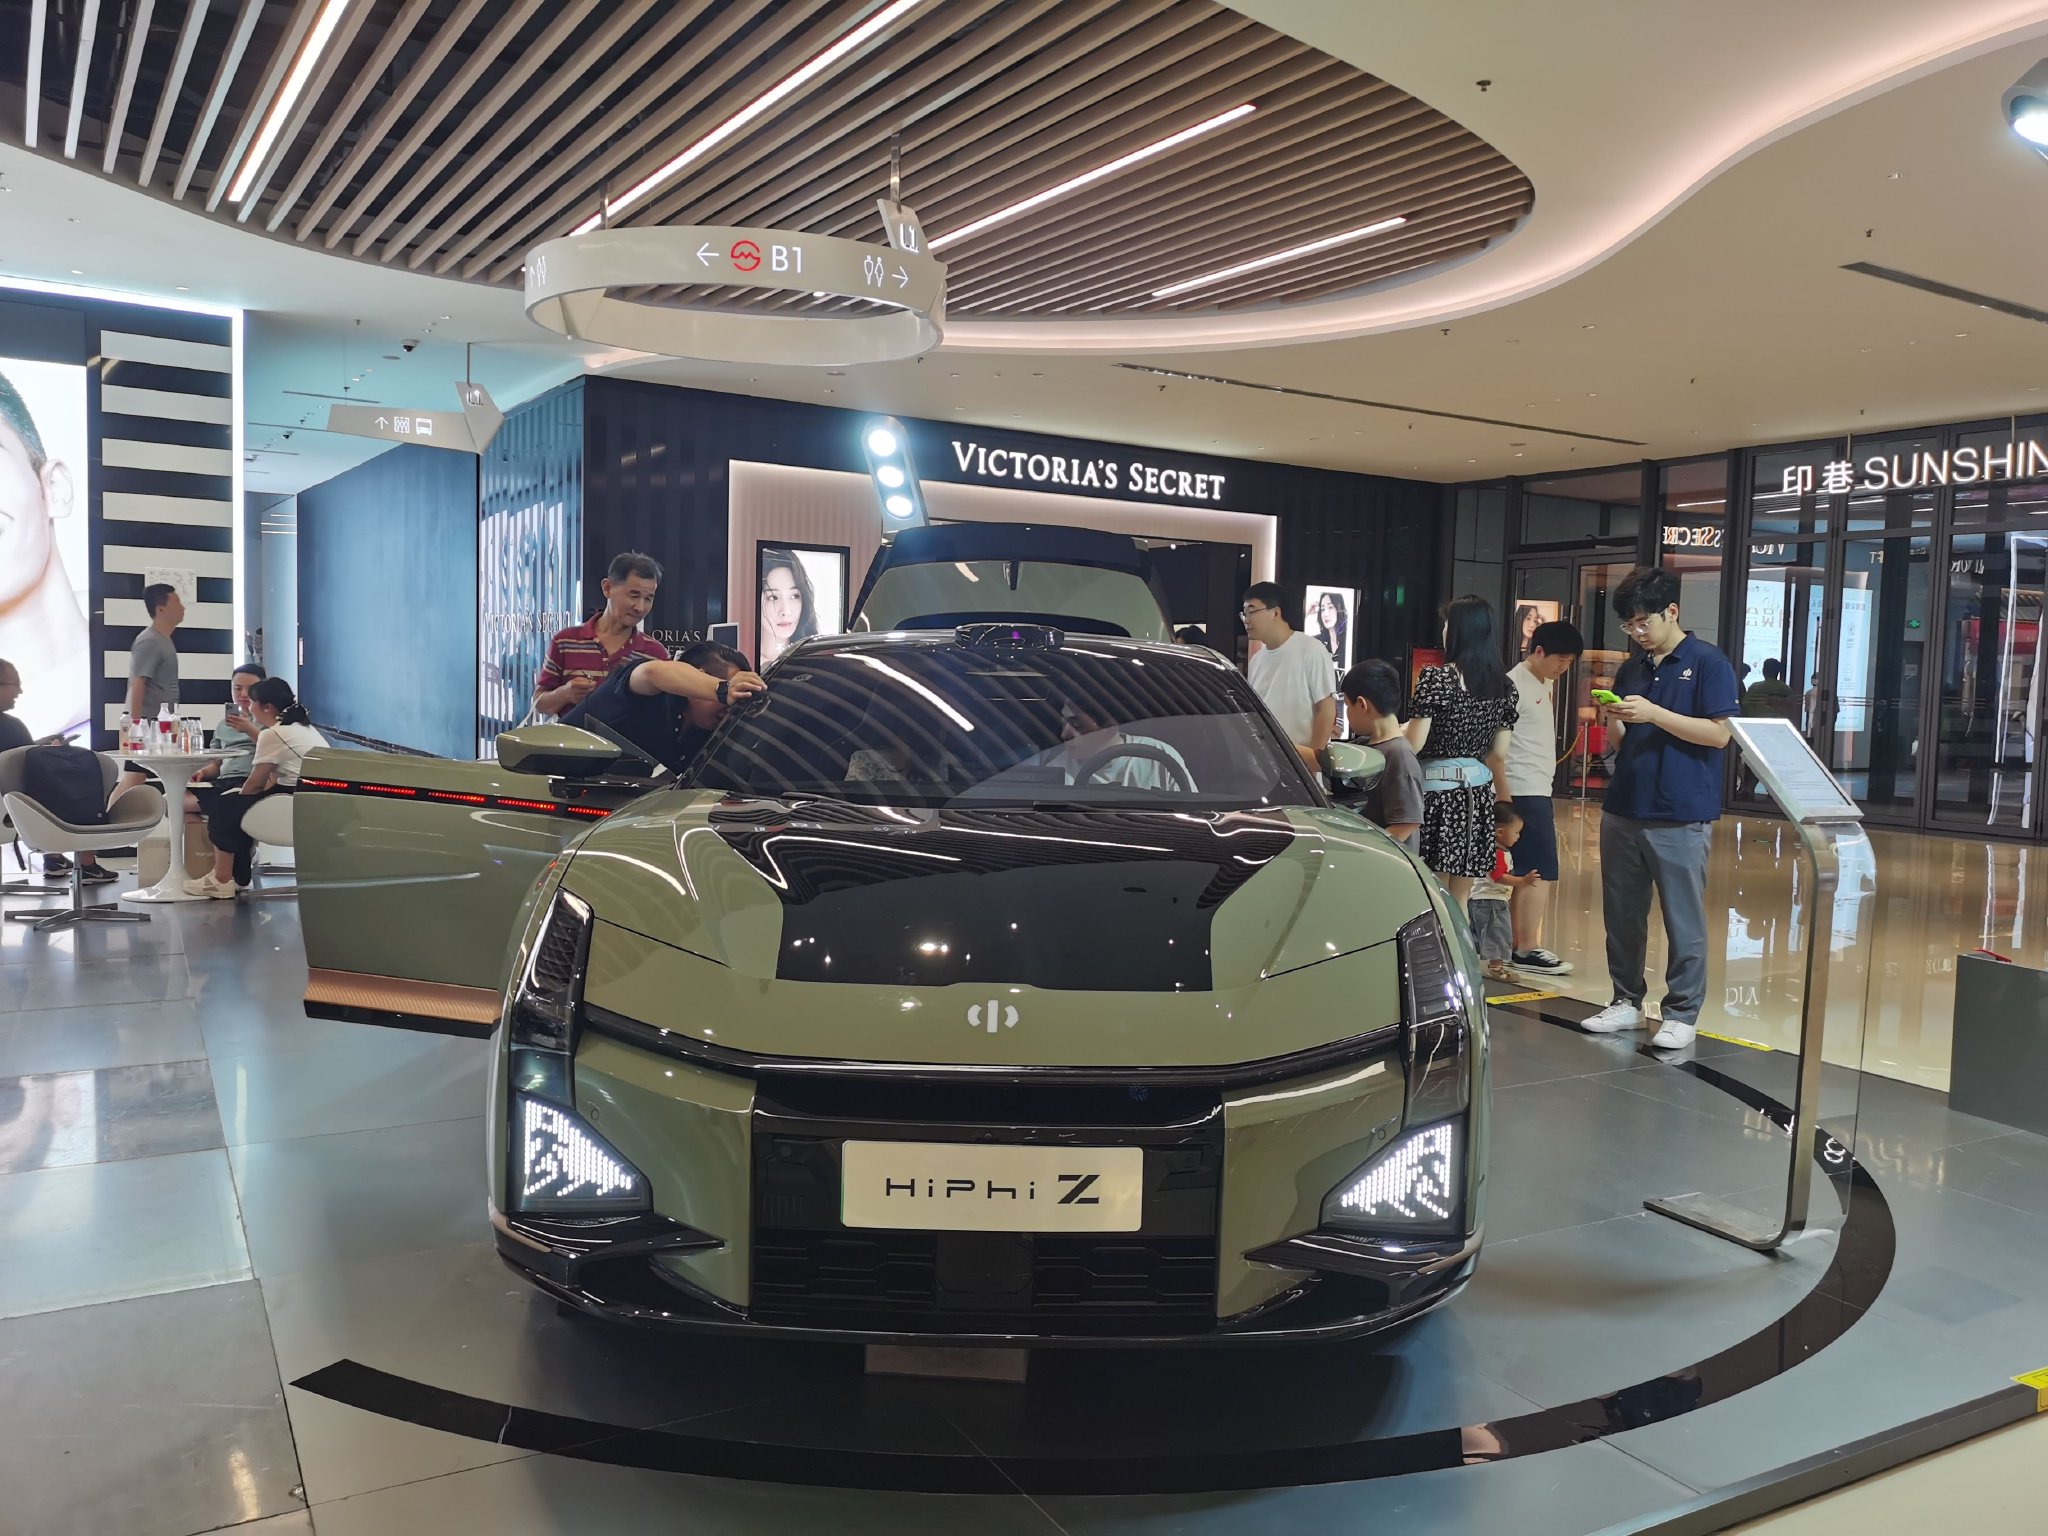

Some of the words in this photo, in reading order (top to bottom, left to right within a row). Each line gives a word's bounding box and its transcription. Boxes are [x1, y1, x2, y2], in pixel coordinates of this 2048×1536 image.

[771, 245, 802, 273] B1
[951, 440, 1118, 490] VICTORIA'S
[1128, 462, 1226, 501] SECRET
[1782, 460, 1854, 496] 印巷
[885, 1177, 1036, 1200] HiPhi
[1057, 1174, 1101, 1204] Z
